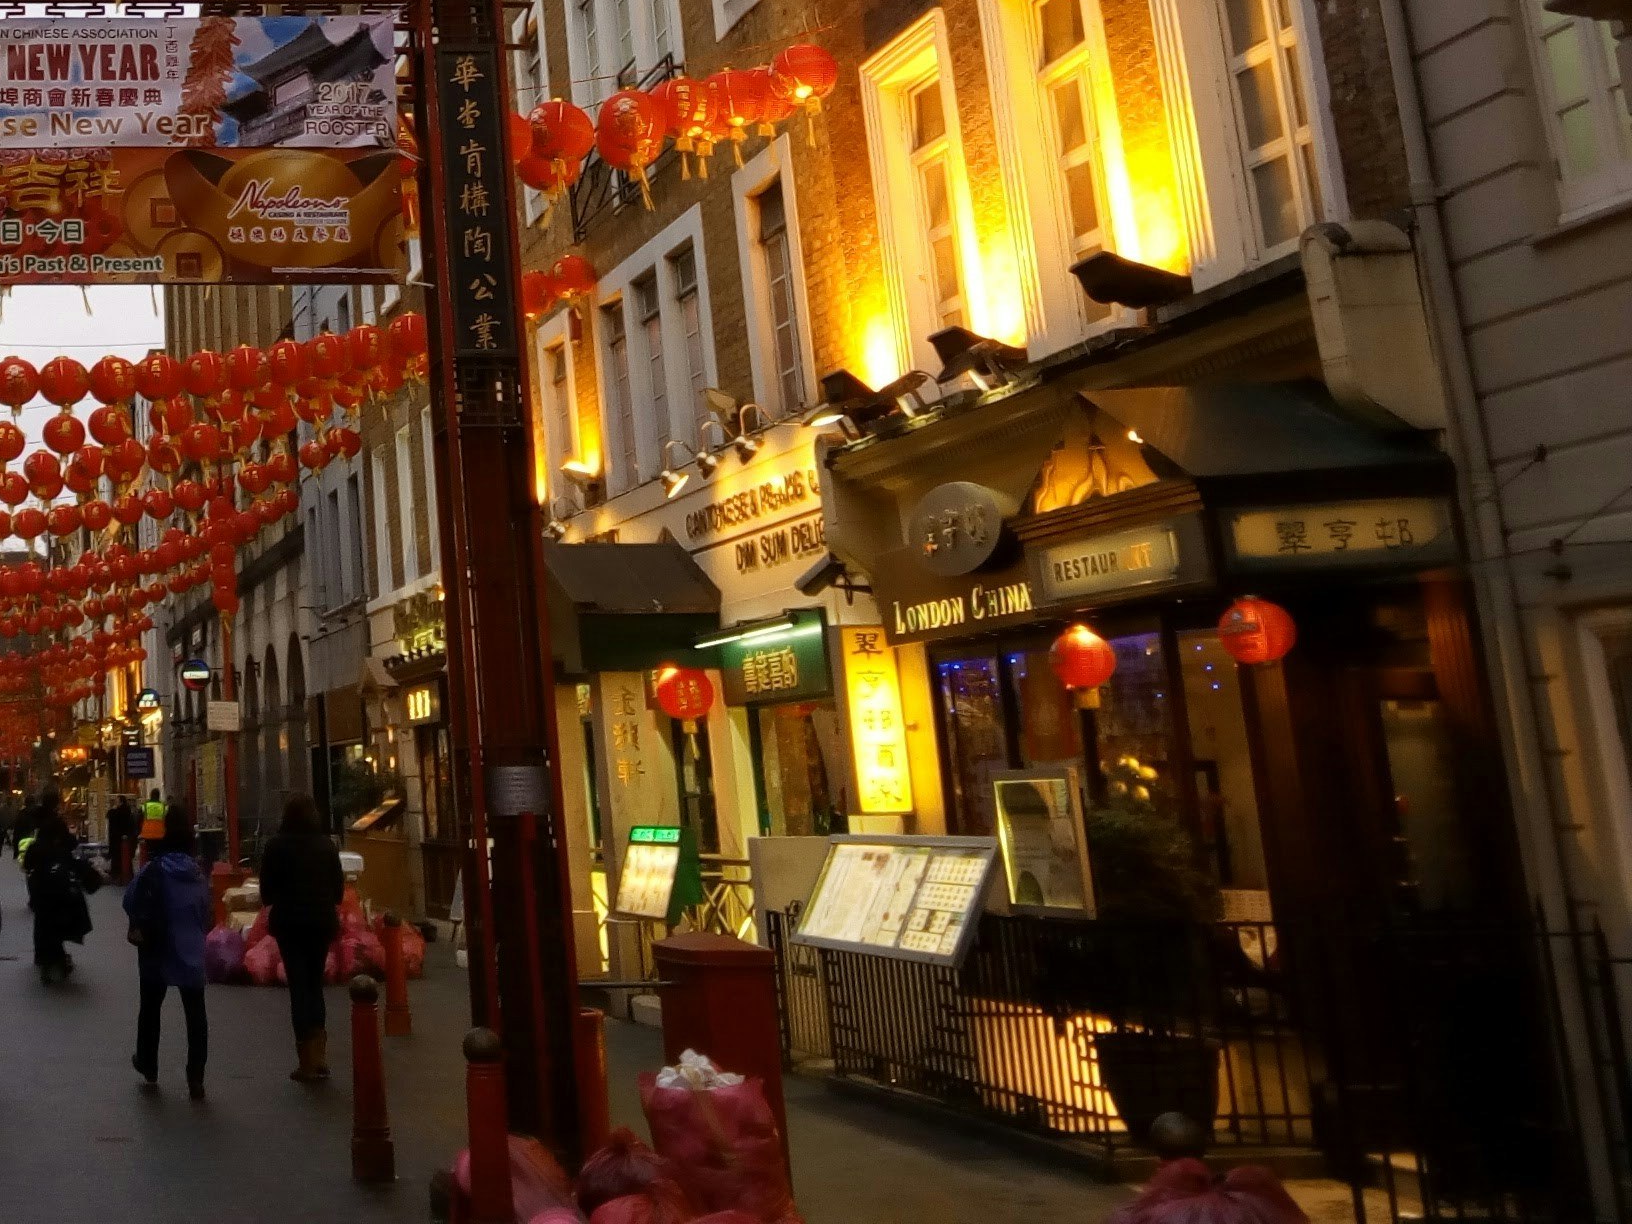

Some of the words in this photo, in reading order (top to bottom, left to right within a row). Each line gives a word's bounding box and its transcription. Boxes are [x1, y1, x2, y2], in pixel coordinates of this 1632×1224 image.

[13, 28, 68, 39] CHINESE
[72, 28, 158, 39] ASSOCIATION
[7, 43, 71, 81] NEW
[78, 43, 160, 81] YEAR
[318, 83, 370, 103] 2017
[308, 104, 341, 116] YEAR
[343, 104, 359, 116] OF
[360, 105, 384, 116] THE
[50, 112, 124, 137] New
[135, 111, 210, 137] Year
[305, 120, 389, 137] ROOSTER
[25, 257, 64, 273] Past
[69, 258, 87, 272] &
[93, 256, 164, 273] Present
[734, 539, 757, 572] DIM
[760, 529, 789, 565] SUM
[892, 596, 966, 636] LONDON
[971, 582, 1033, 621] CHINA
